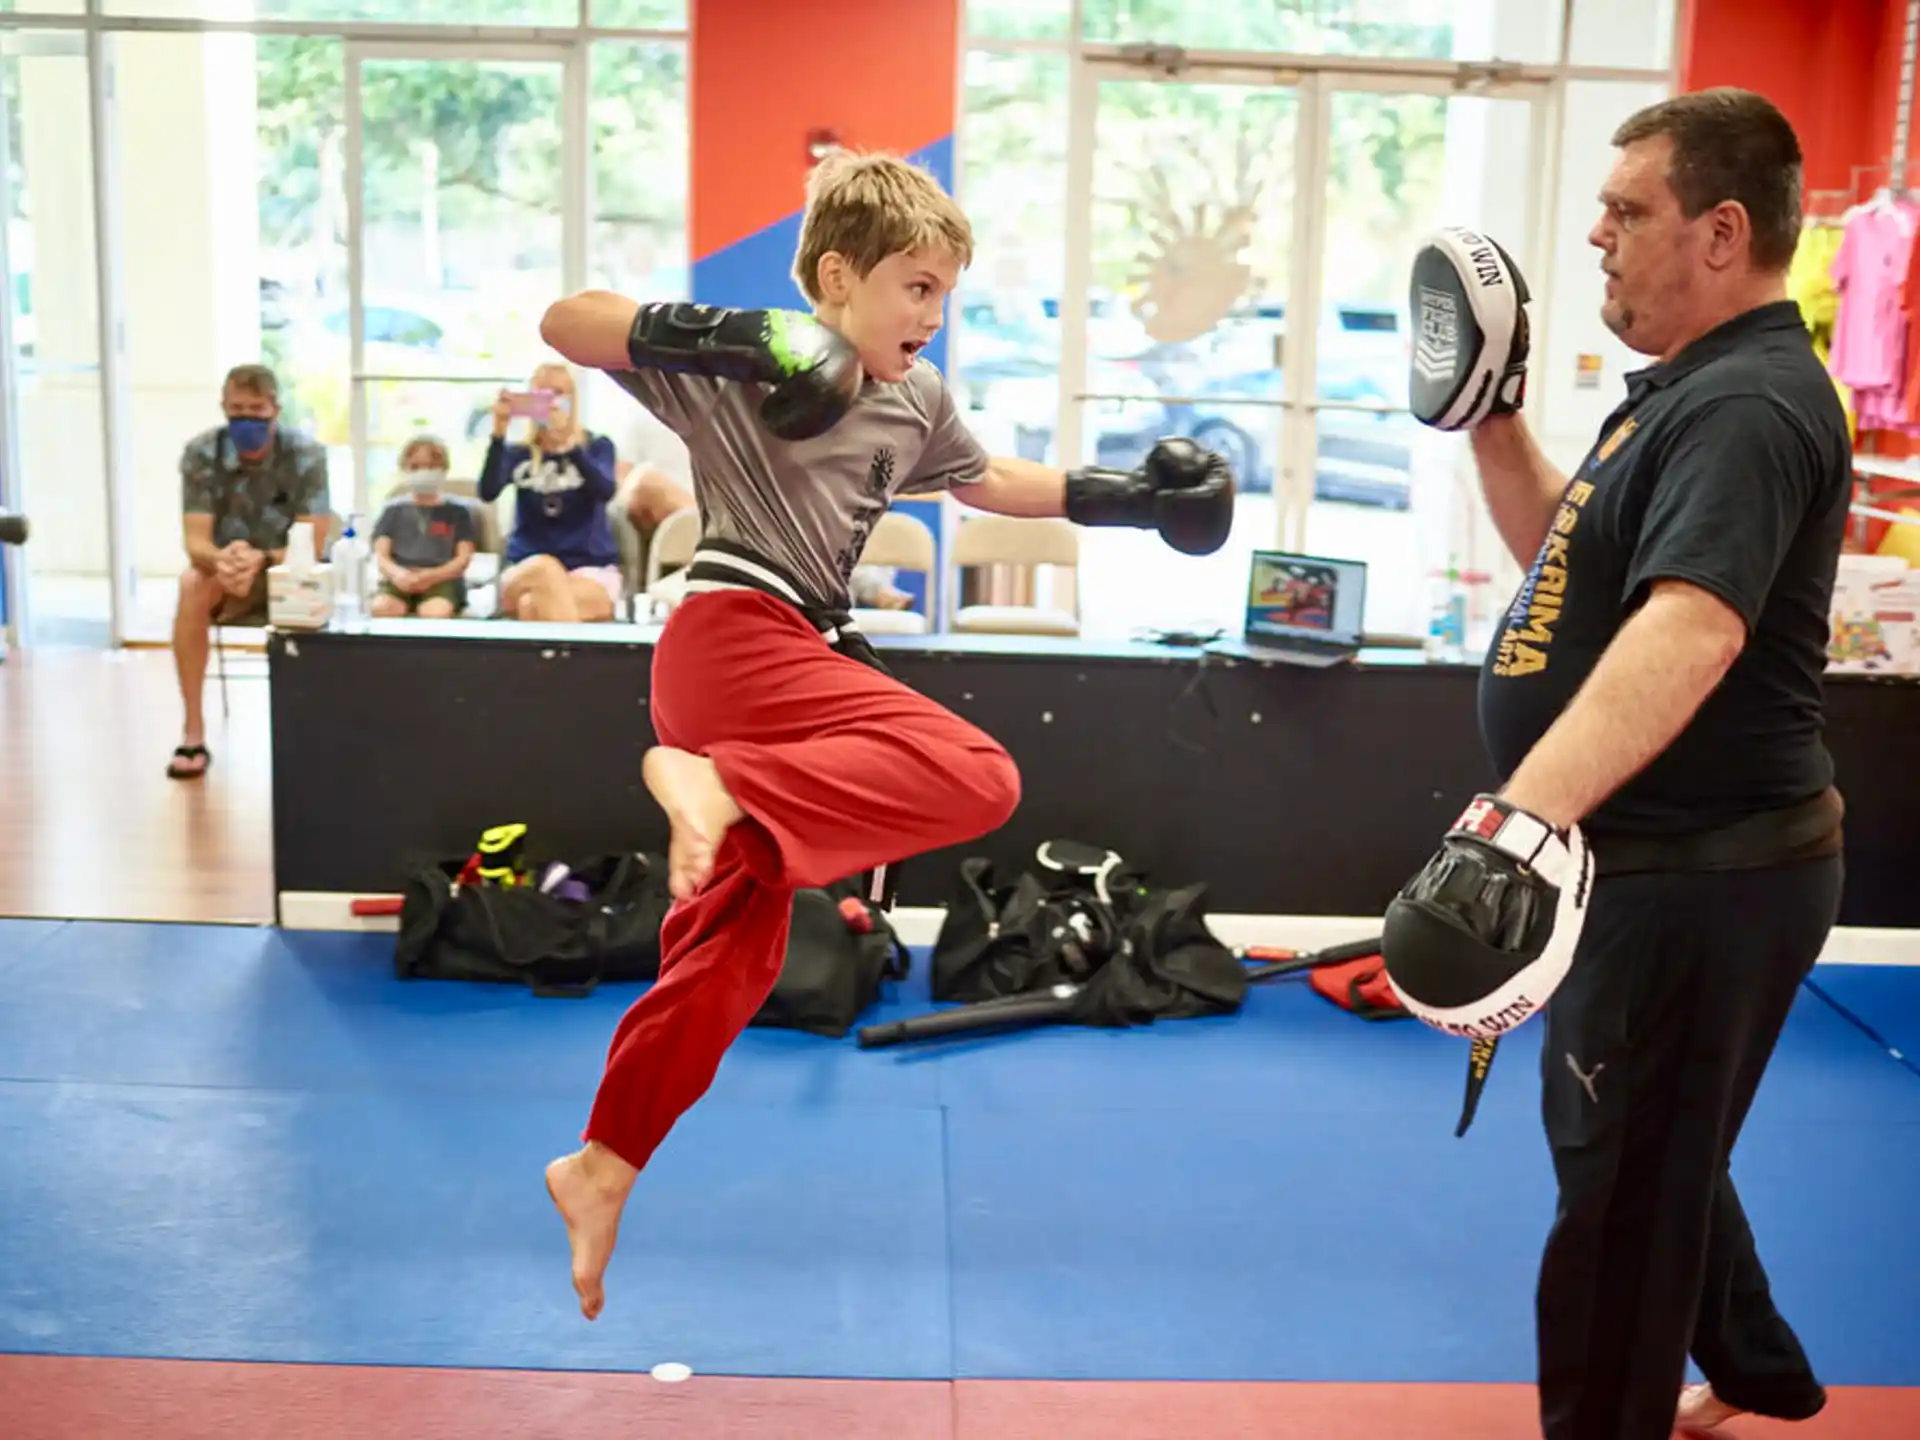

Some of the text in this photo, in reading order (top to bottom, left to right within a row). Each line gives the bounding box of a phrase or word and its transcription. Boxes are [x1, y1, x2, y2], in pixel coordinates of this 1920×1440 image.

[1470, 246, 1503, 287] WIN
[1508, 479, 1595, 676] ESKRIMA
[1492, 627, 1519, 676] ARTS
[1478, 995, 1534, 1032] WIN
